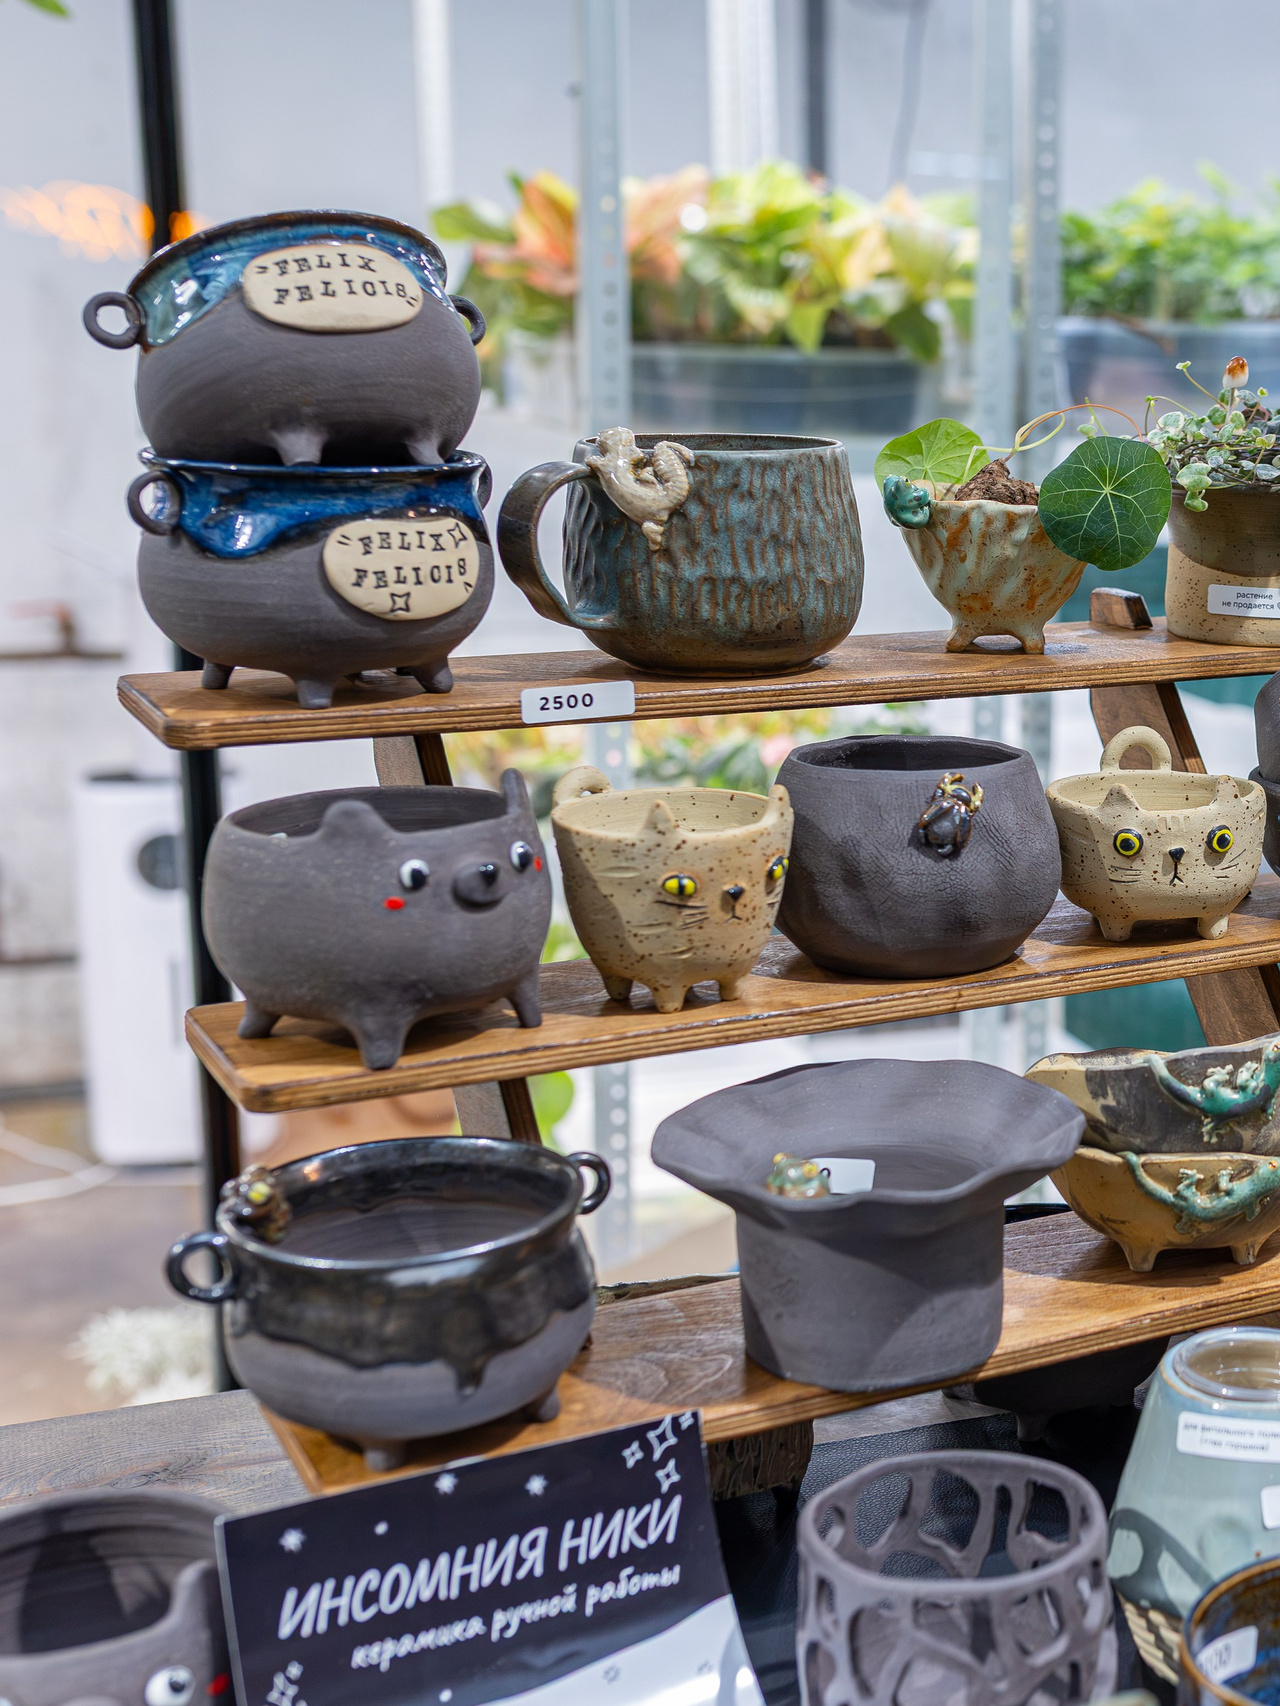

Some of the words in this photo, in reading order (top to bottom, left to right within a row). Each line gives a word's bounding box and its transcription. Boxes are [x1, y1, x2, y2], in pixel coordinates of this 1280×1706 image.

[1236, 592, 1273, 600] растение
[1233, 602, 1275, 610] продается
[539, 693, 594, 711] 2500
[278, 1526, 549, 1640] ИНСОМНИЯ
[558, 1494, 682, 1572] НИКИ
[350, 1616, 487, 1673] керамика
[491, 1583, 577, 1643] ручной
[585, 1564, 681, 1617] работы
